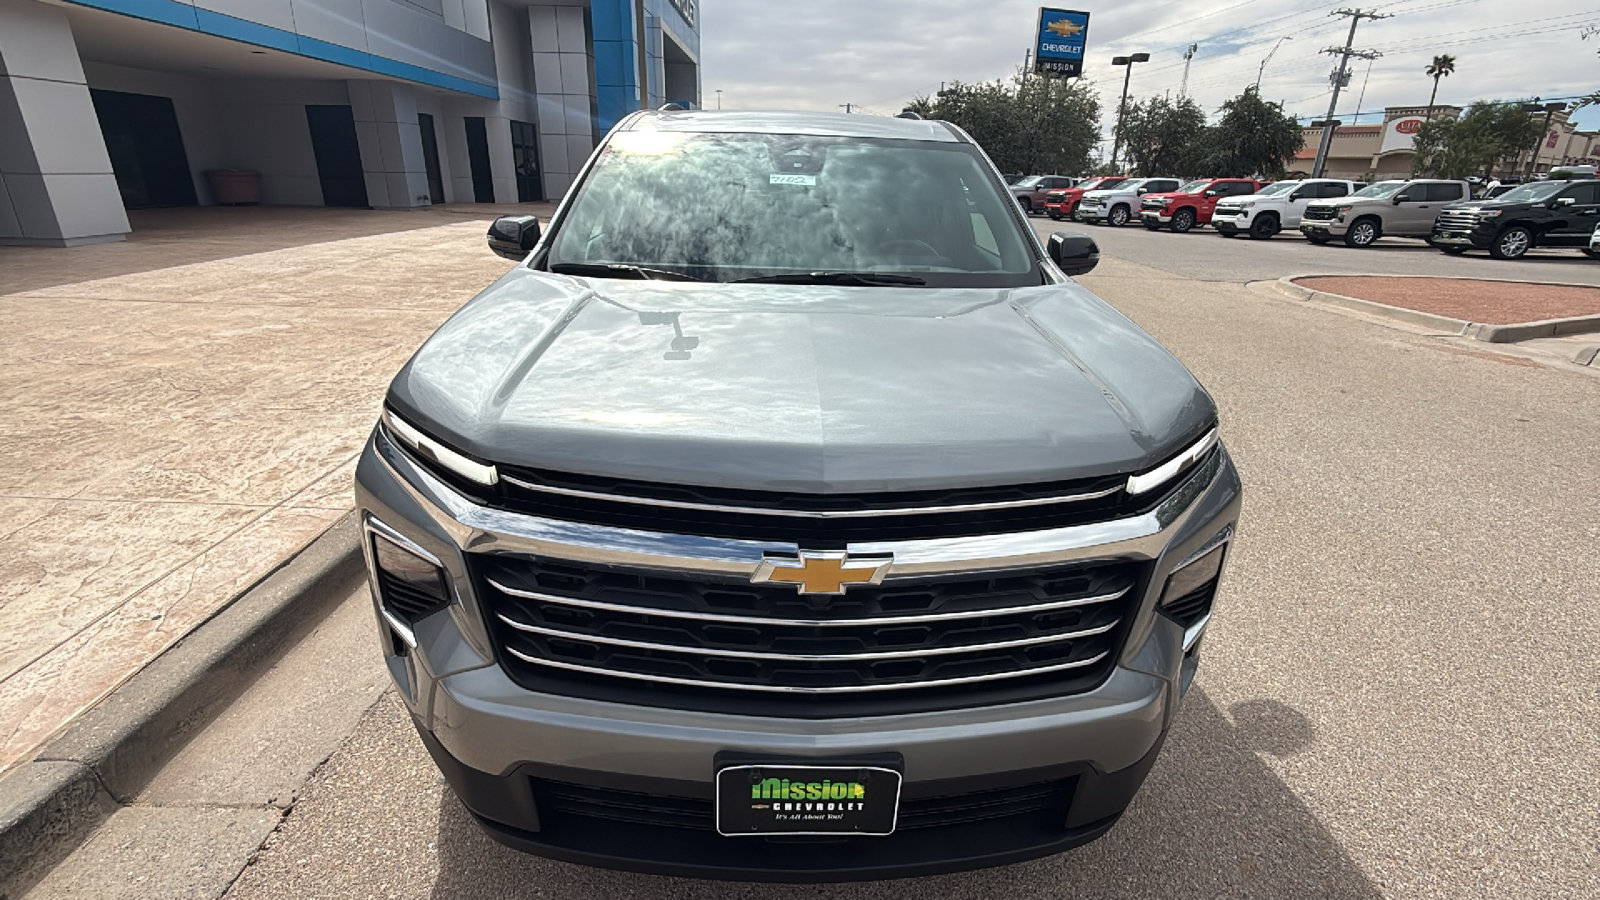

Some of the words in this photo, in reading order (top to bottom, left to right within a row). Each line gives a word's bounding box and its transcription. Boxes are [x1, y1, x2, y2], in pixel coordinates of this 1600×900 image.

[1042, 43, 1082, 54] CHEVROLET
[1045, 62, 1074, 71] MISSION
[773, 803, 864, 811] CHEVROLET
[827, 813, 844, 821] You!
